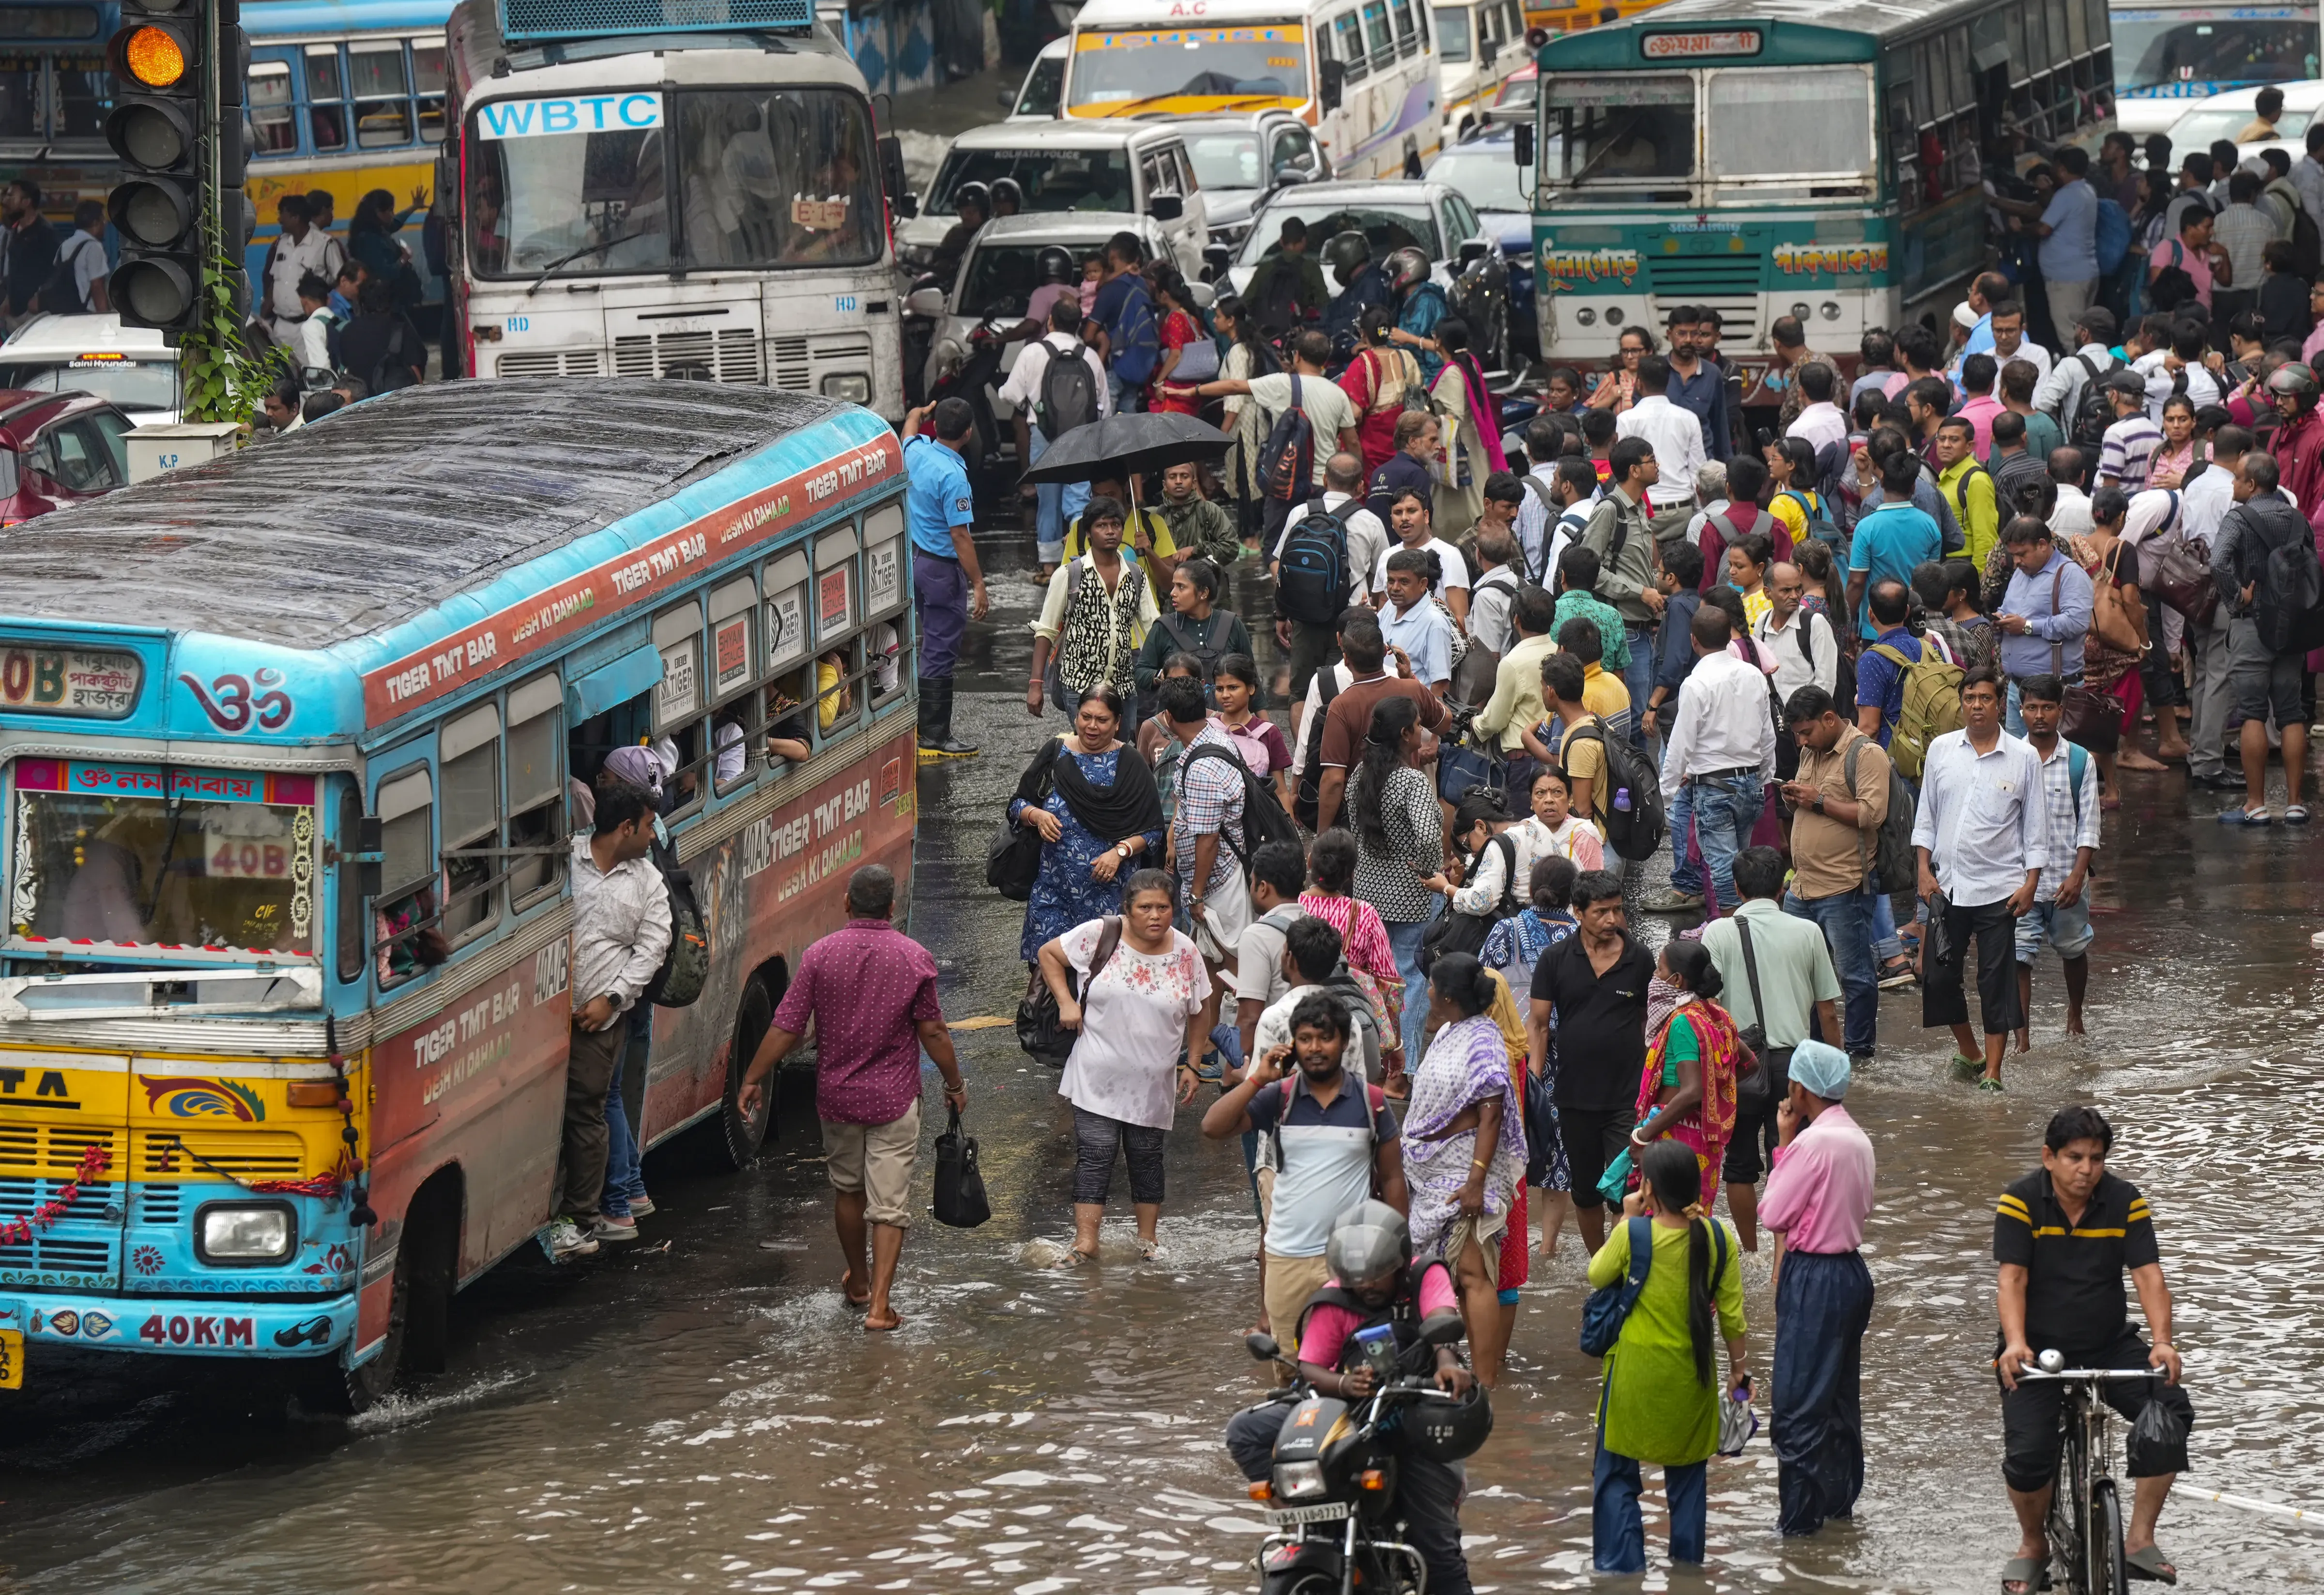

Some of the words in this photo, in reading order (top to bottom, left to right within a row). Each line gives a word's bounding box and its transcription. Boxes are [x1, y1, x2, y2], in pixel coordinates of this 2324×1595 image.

[1170, 1, 1207, 17] A.C
[483, 94, 657, 137] WBTC
[1042, 150, 1080, 160] POLICE
[836, 296, 856, 311] HD
[507, 317, 529, 332] HD
[69, 360, 92, 368] Saini
[93, 360, 136, 368] Hyundai
[159, 454, 178, 469] K.P
[805, 470, 838, 503] TIGER
[839, 458, 863, 487] TMT
[863, 448, 886, 476] BAR
[720, 515, 745, 544] DESH
[741, 511, 755, 531] KI
[754, 494, 790, 527] DAHAAD
[611, 560, 651, 595] TIGER
[649, 545, 679, 577] TMT
[678, 532, 706, 563] BAR
[882, 551, 891, 564] SEL
[822, 576, 844, 599] SHYAM
[877, 563, 896, 590] TIGER
[512, 612, 540, 644] DESH
[539, 607, 552, 629] KI
[553, 587, 595, 623] DAHAAD
[783, 600, 794, 614] SEL
[836, 611, 845, 622] METAL
[719, 628, 744, 653] SHYAM
[386, 662, 430, 703] TIGER
[432, 645, 464, 681] TMT
[466, 631, 497, 667] BAR
[674, 654, 687, 669] SEL
[720, 644, 745, 668] METALICS
[0, 650, 67, 705] 0B
[670, 666, 692, 696] TIGER
[734, 665, 745, 675] METAL
[171, 769, 255, 798] শিবায়
[771, 813, 810, 863] TIGER
[814, 794, 842, 839] TMT
[844, 778, 871, 822] BAR
[211, 842, 287, 877] 40B
[778, 861, 807, 902] DESH
[809, 853, 820, 885] KI
[822, 829, 862, 878] DAHAAD
[414, 1019, 456, 1069] TIGER
[459, 998, 489, 1043] TMT
[492, 982, 520, 1025] BAR
[423, 1066, 451, 1106] DESH
[453, 1056, 465, 1086] KI
[467, 1031, 511, 1079] DAHAAD
